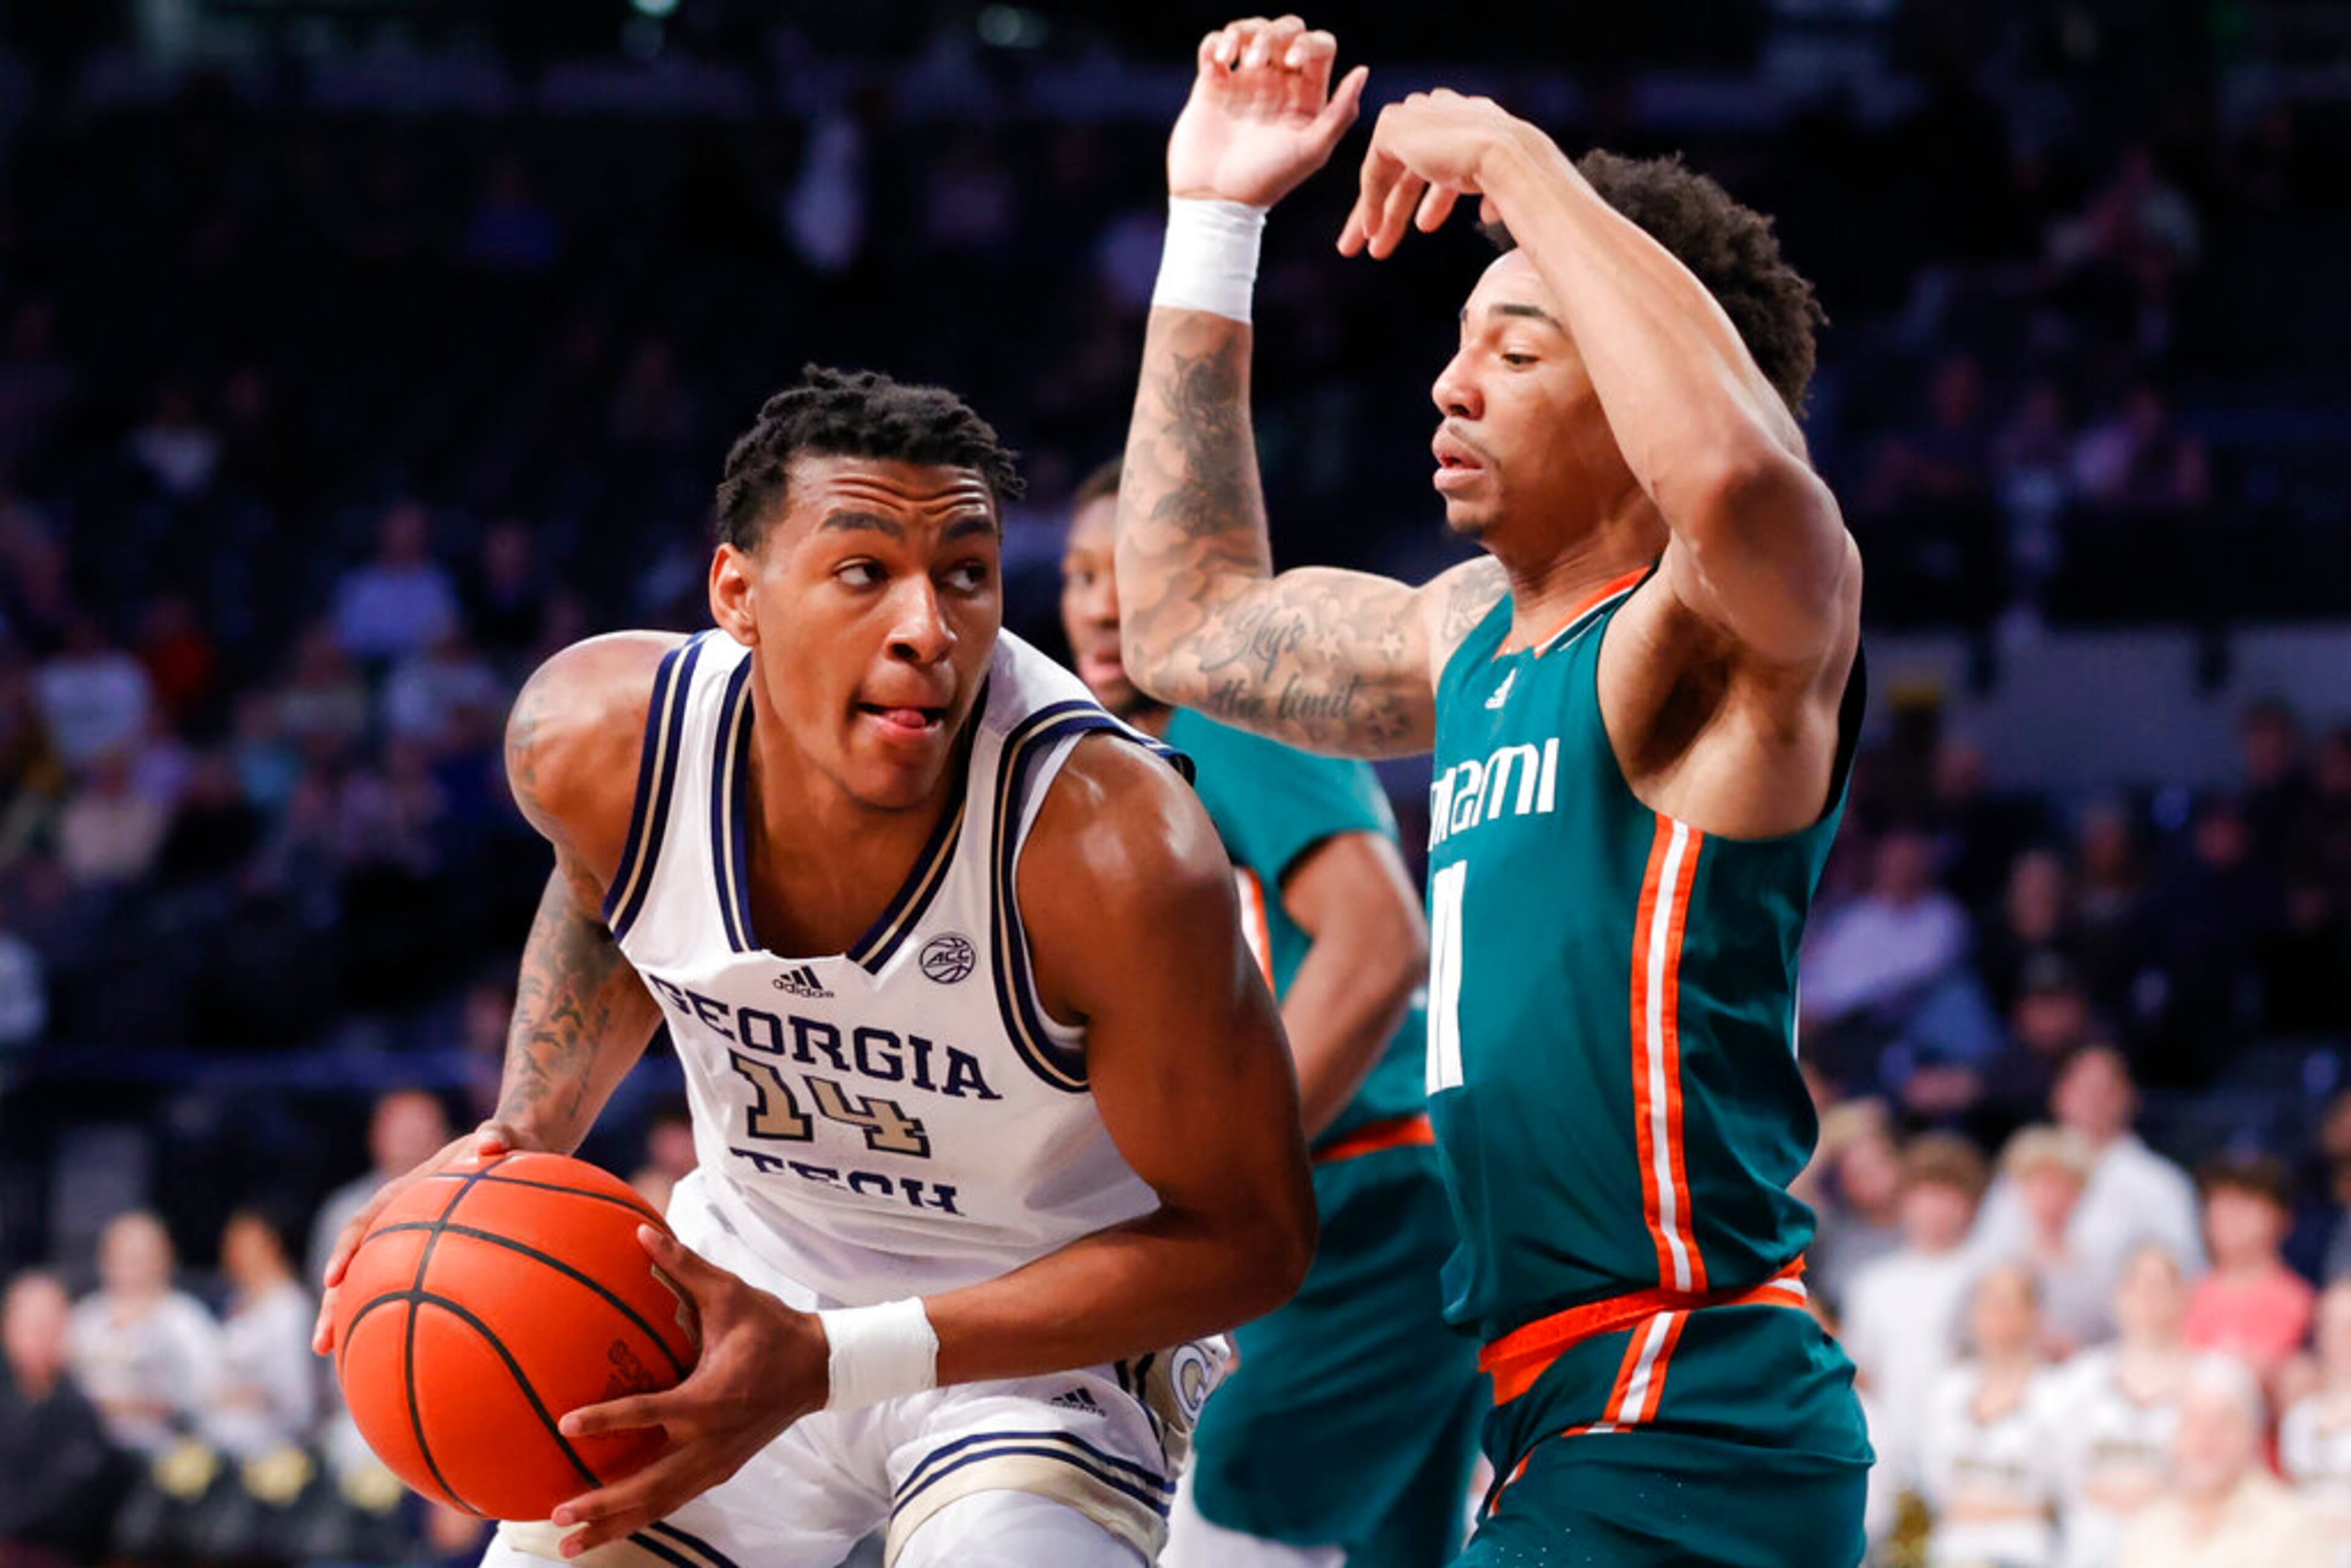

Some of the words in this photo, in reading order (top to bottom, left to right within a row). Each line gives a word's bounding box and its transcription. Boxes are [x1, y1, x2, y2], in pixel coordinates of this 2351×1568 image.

[649, 974, 1002, 1100] GEORGIA
[773, 978, 835, 999] adidas
[729, 1049, 931, 1158] 14
